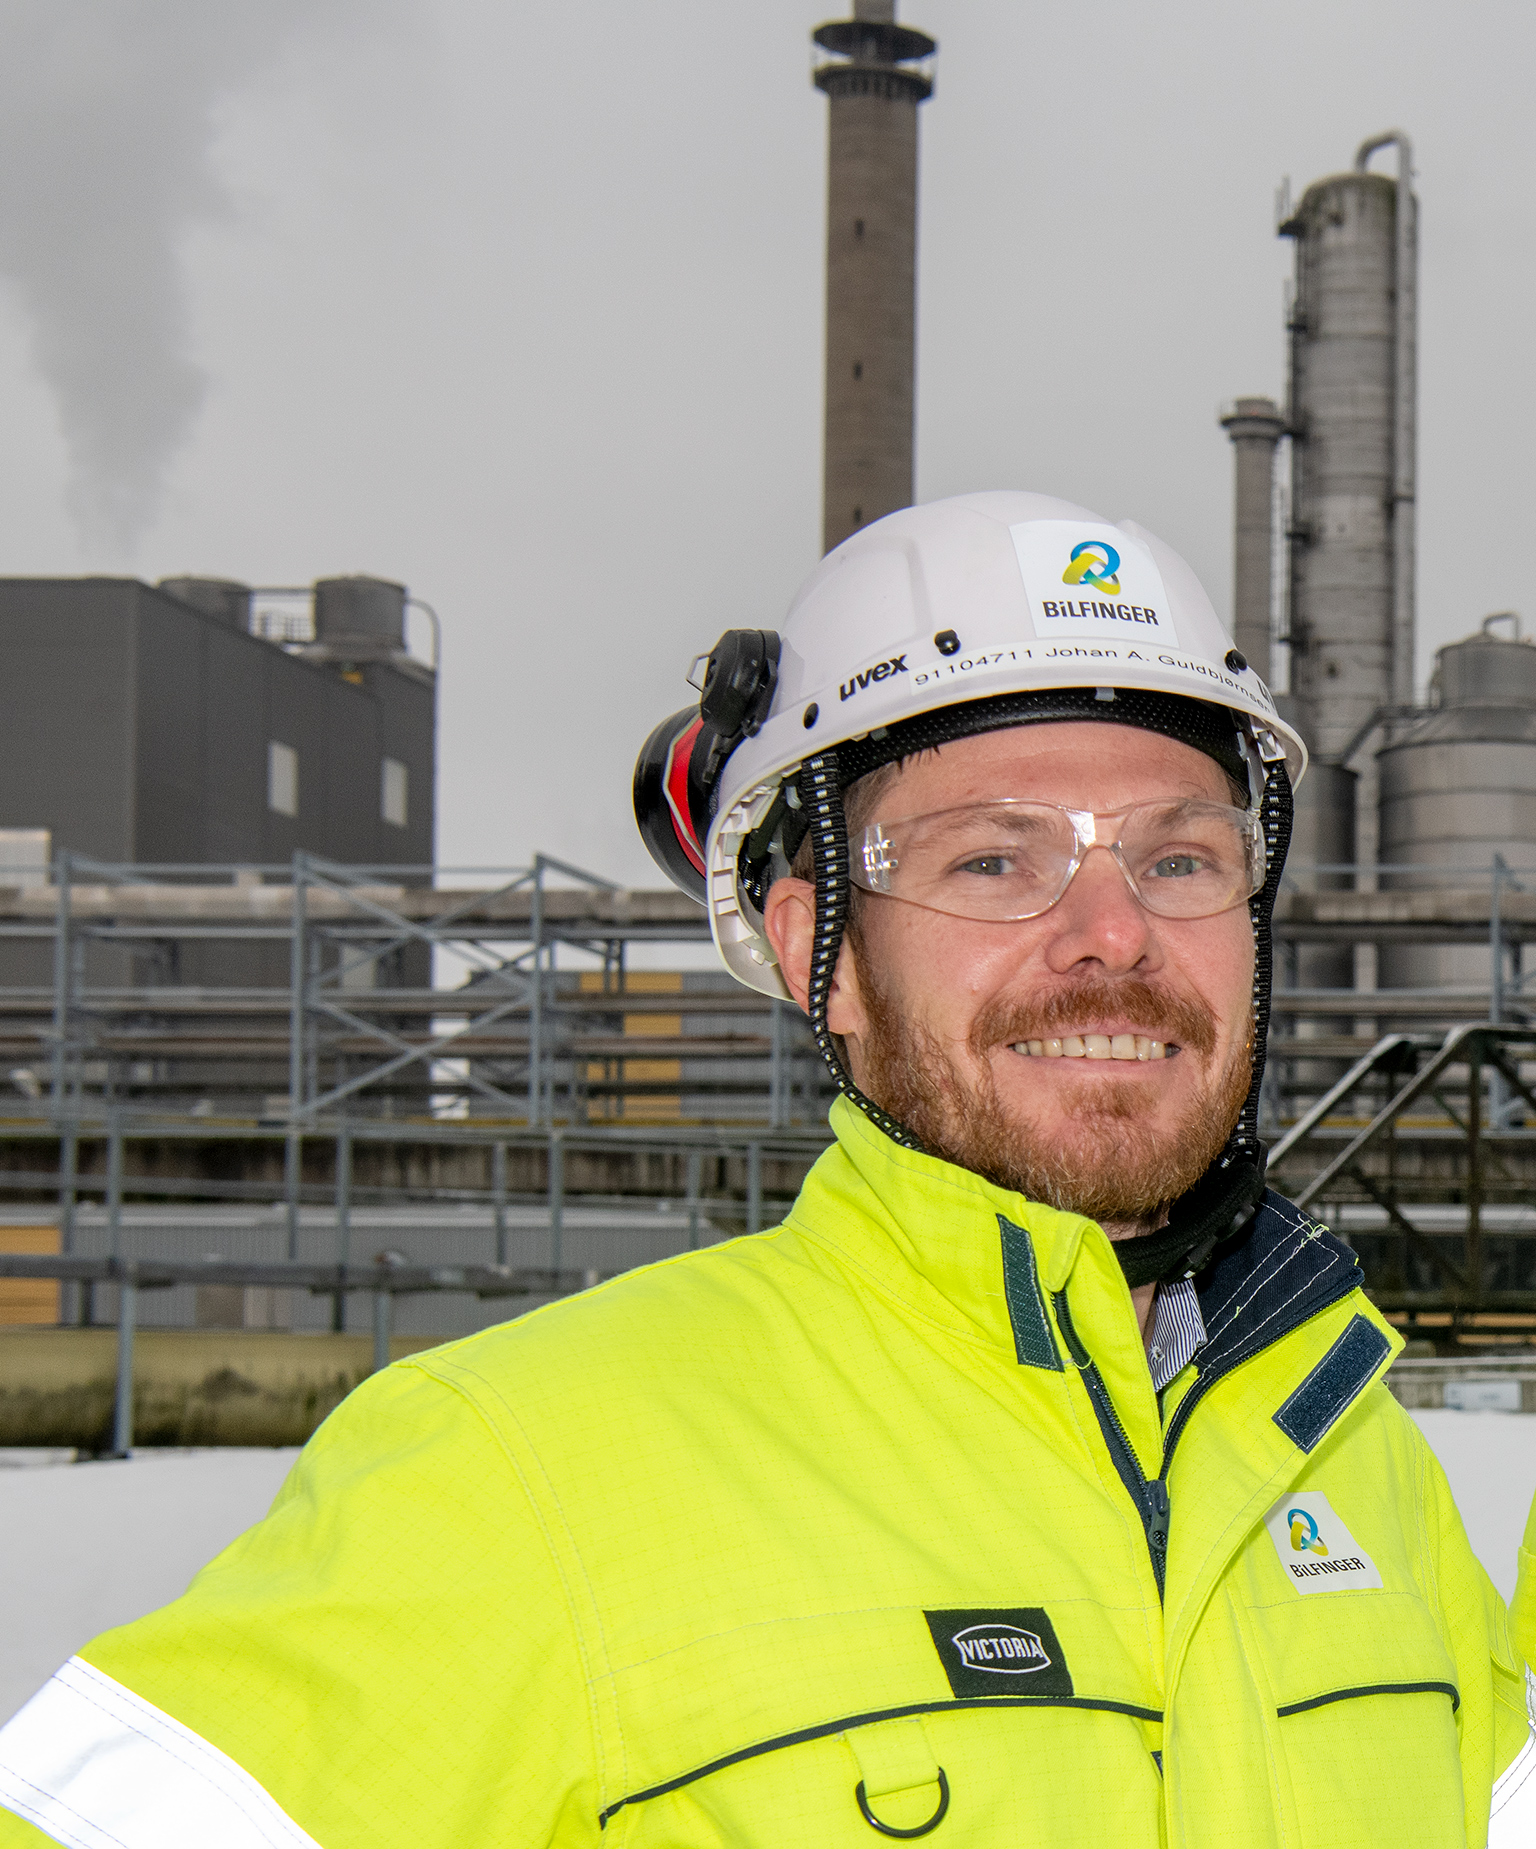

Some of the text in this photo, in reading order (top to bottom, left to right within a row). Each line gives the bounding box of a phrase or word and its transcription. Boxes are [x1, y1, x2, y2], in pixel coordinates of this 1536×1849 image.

[1043, 601, 1160, 626] BiLFINGER
[839, 653, 909, 701] uvex
[915, 650, 1033, 686] 91104711
[1046, 646, 1118, 660] Johan
[1128, 650, 1151, 662] A.
[1290, 1556, 1367, 1579] BiLFINGER
[961, 1637, 1044, 1661] VICTORIA
